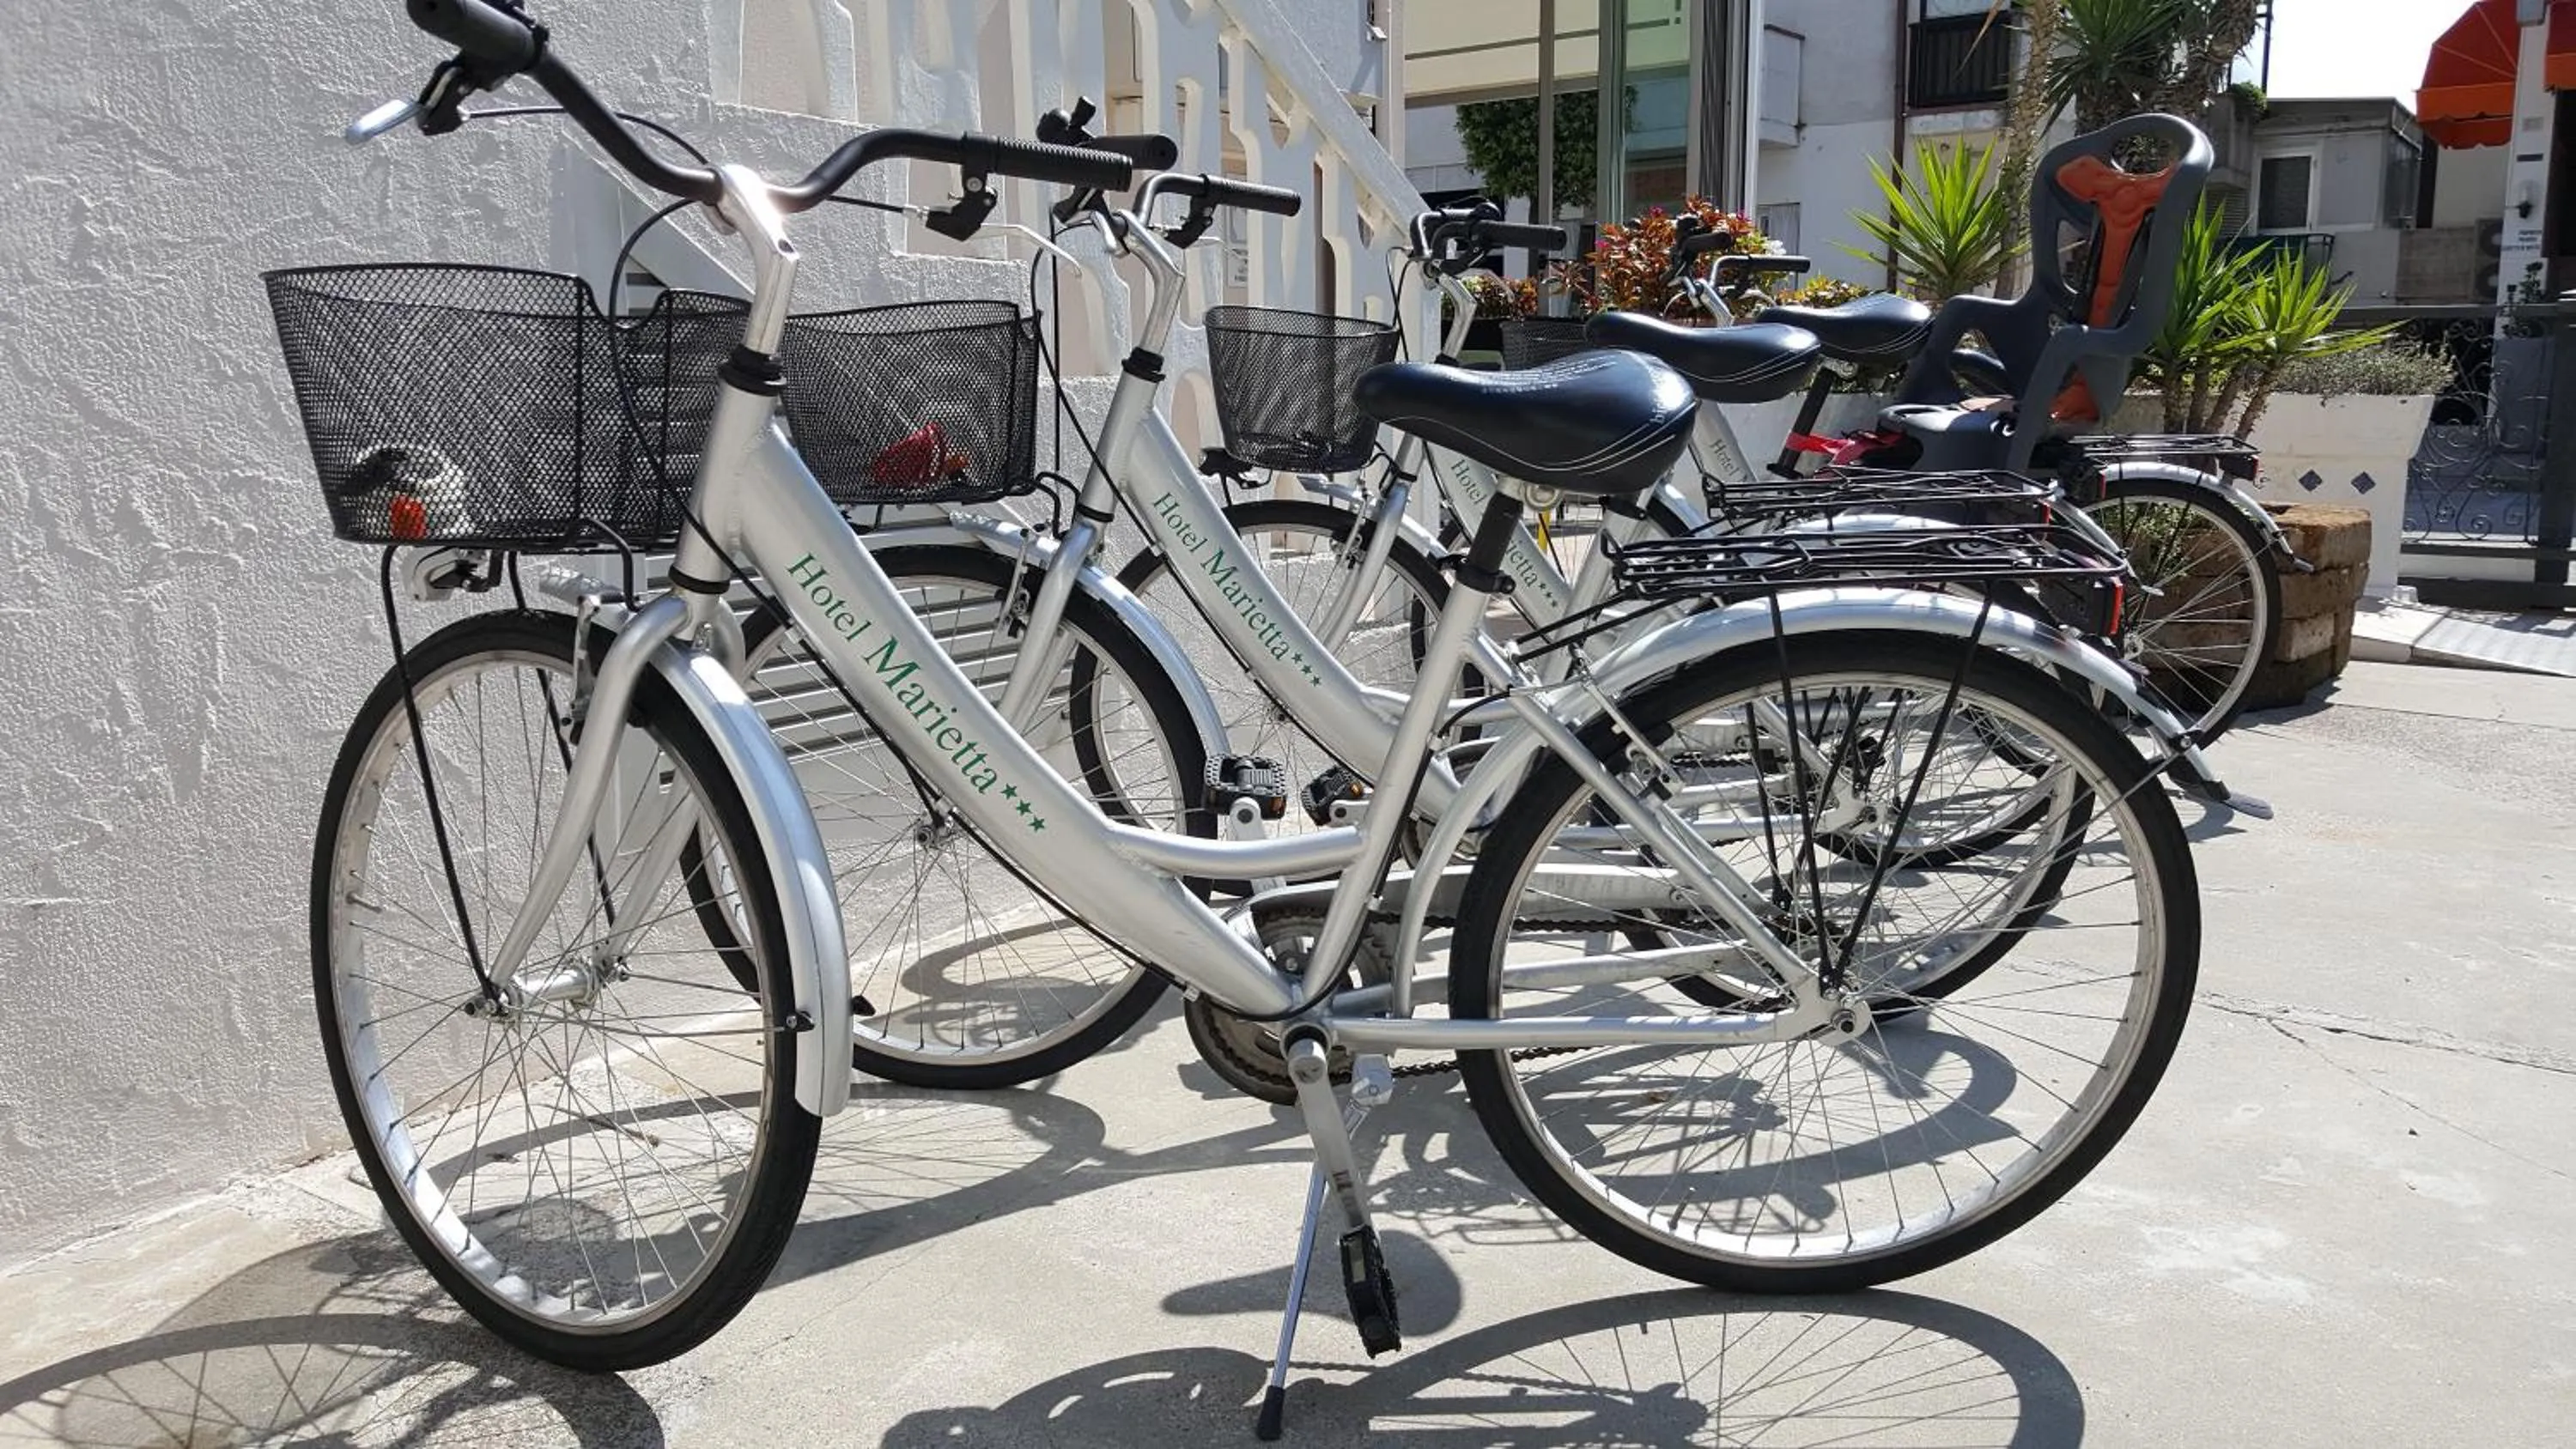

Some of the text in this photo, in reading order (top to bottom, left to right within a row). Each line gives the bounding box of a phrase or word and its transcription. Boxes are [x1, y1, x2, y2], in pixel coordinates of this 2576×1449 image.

[1451, 459, 1486, 505] Hotel
[1153, 493, 1291, 660] Hotel Marietta
[787, 554, 998, 794] Hotel Marietta
